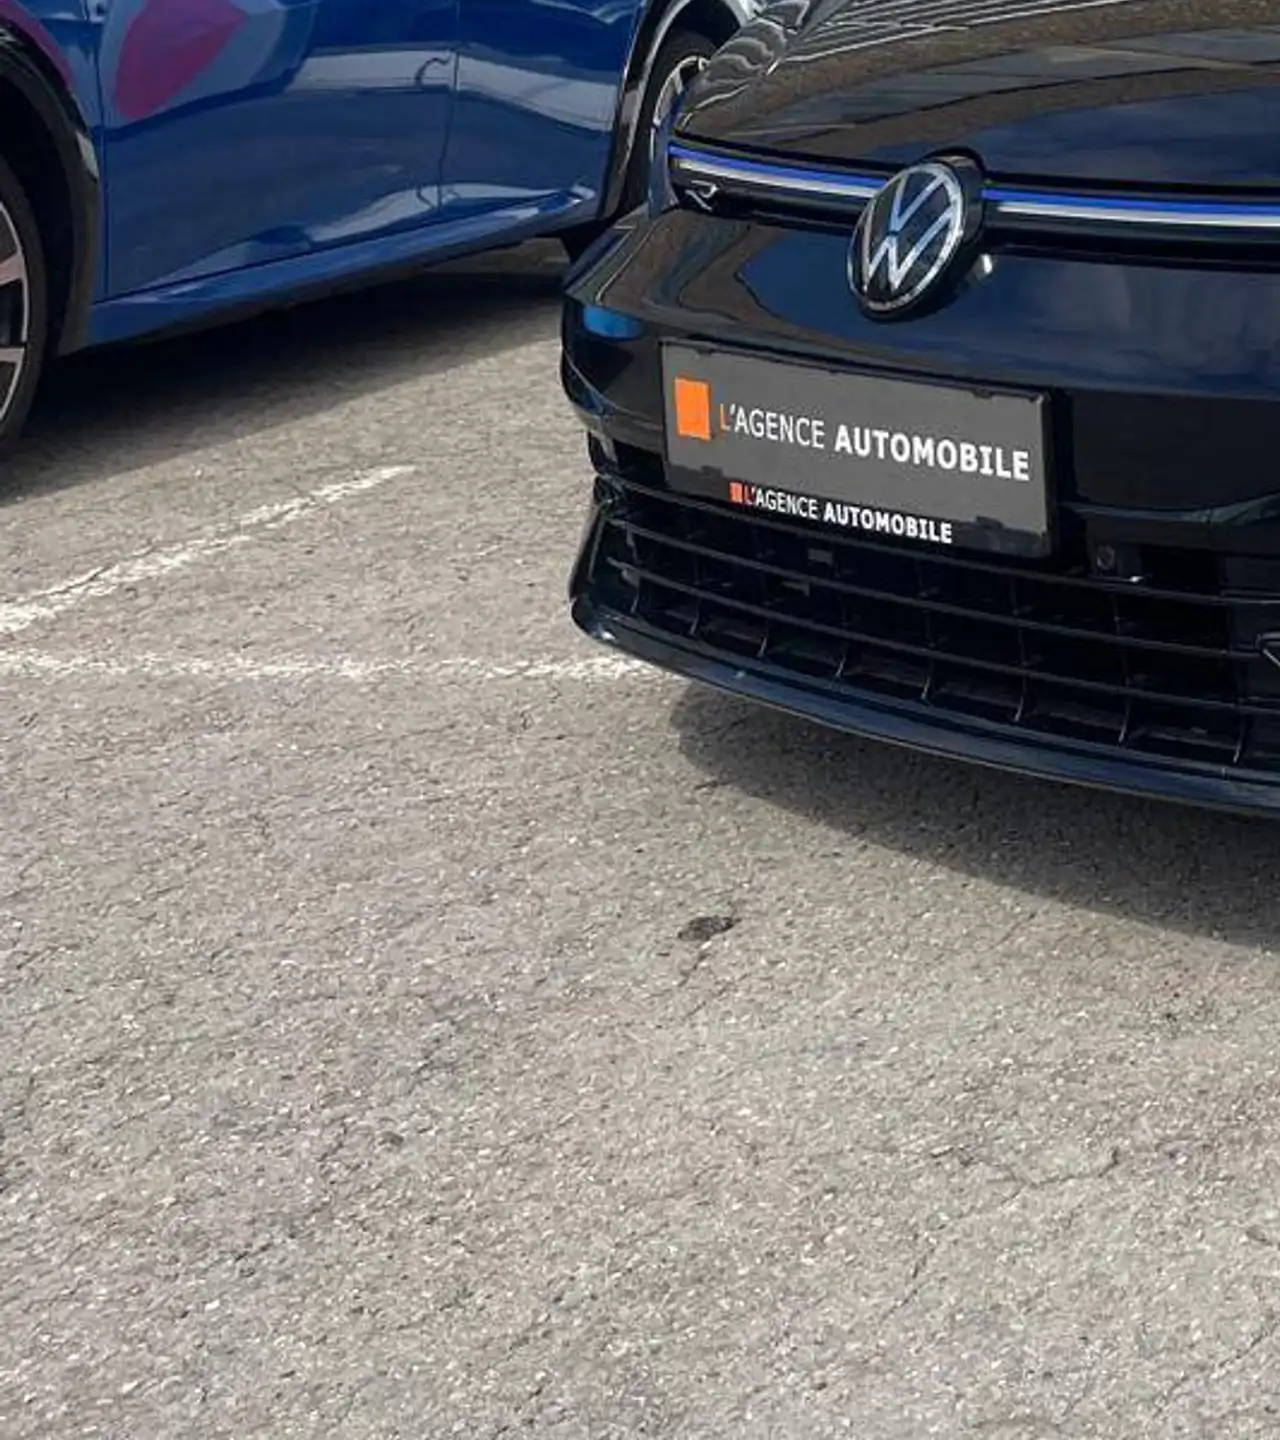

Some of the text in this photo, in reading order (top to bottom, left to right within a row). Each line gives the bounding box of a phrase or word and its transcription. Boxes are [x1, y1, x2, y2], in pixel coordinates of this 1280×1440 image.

[719, 403, 1030, 481] L'AGENCE AUTOMOBILE
[744, 485, 952, 544] L'AGENCE AUTOMOBILE
